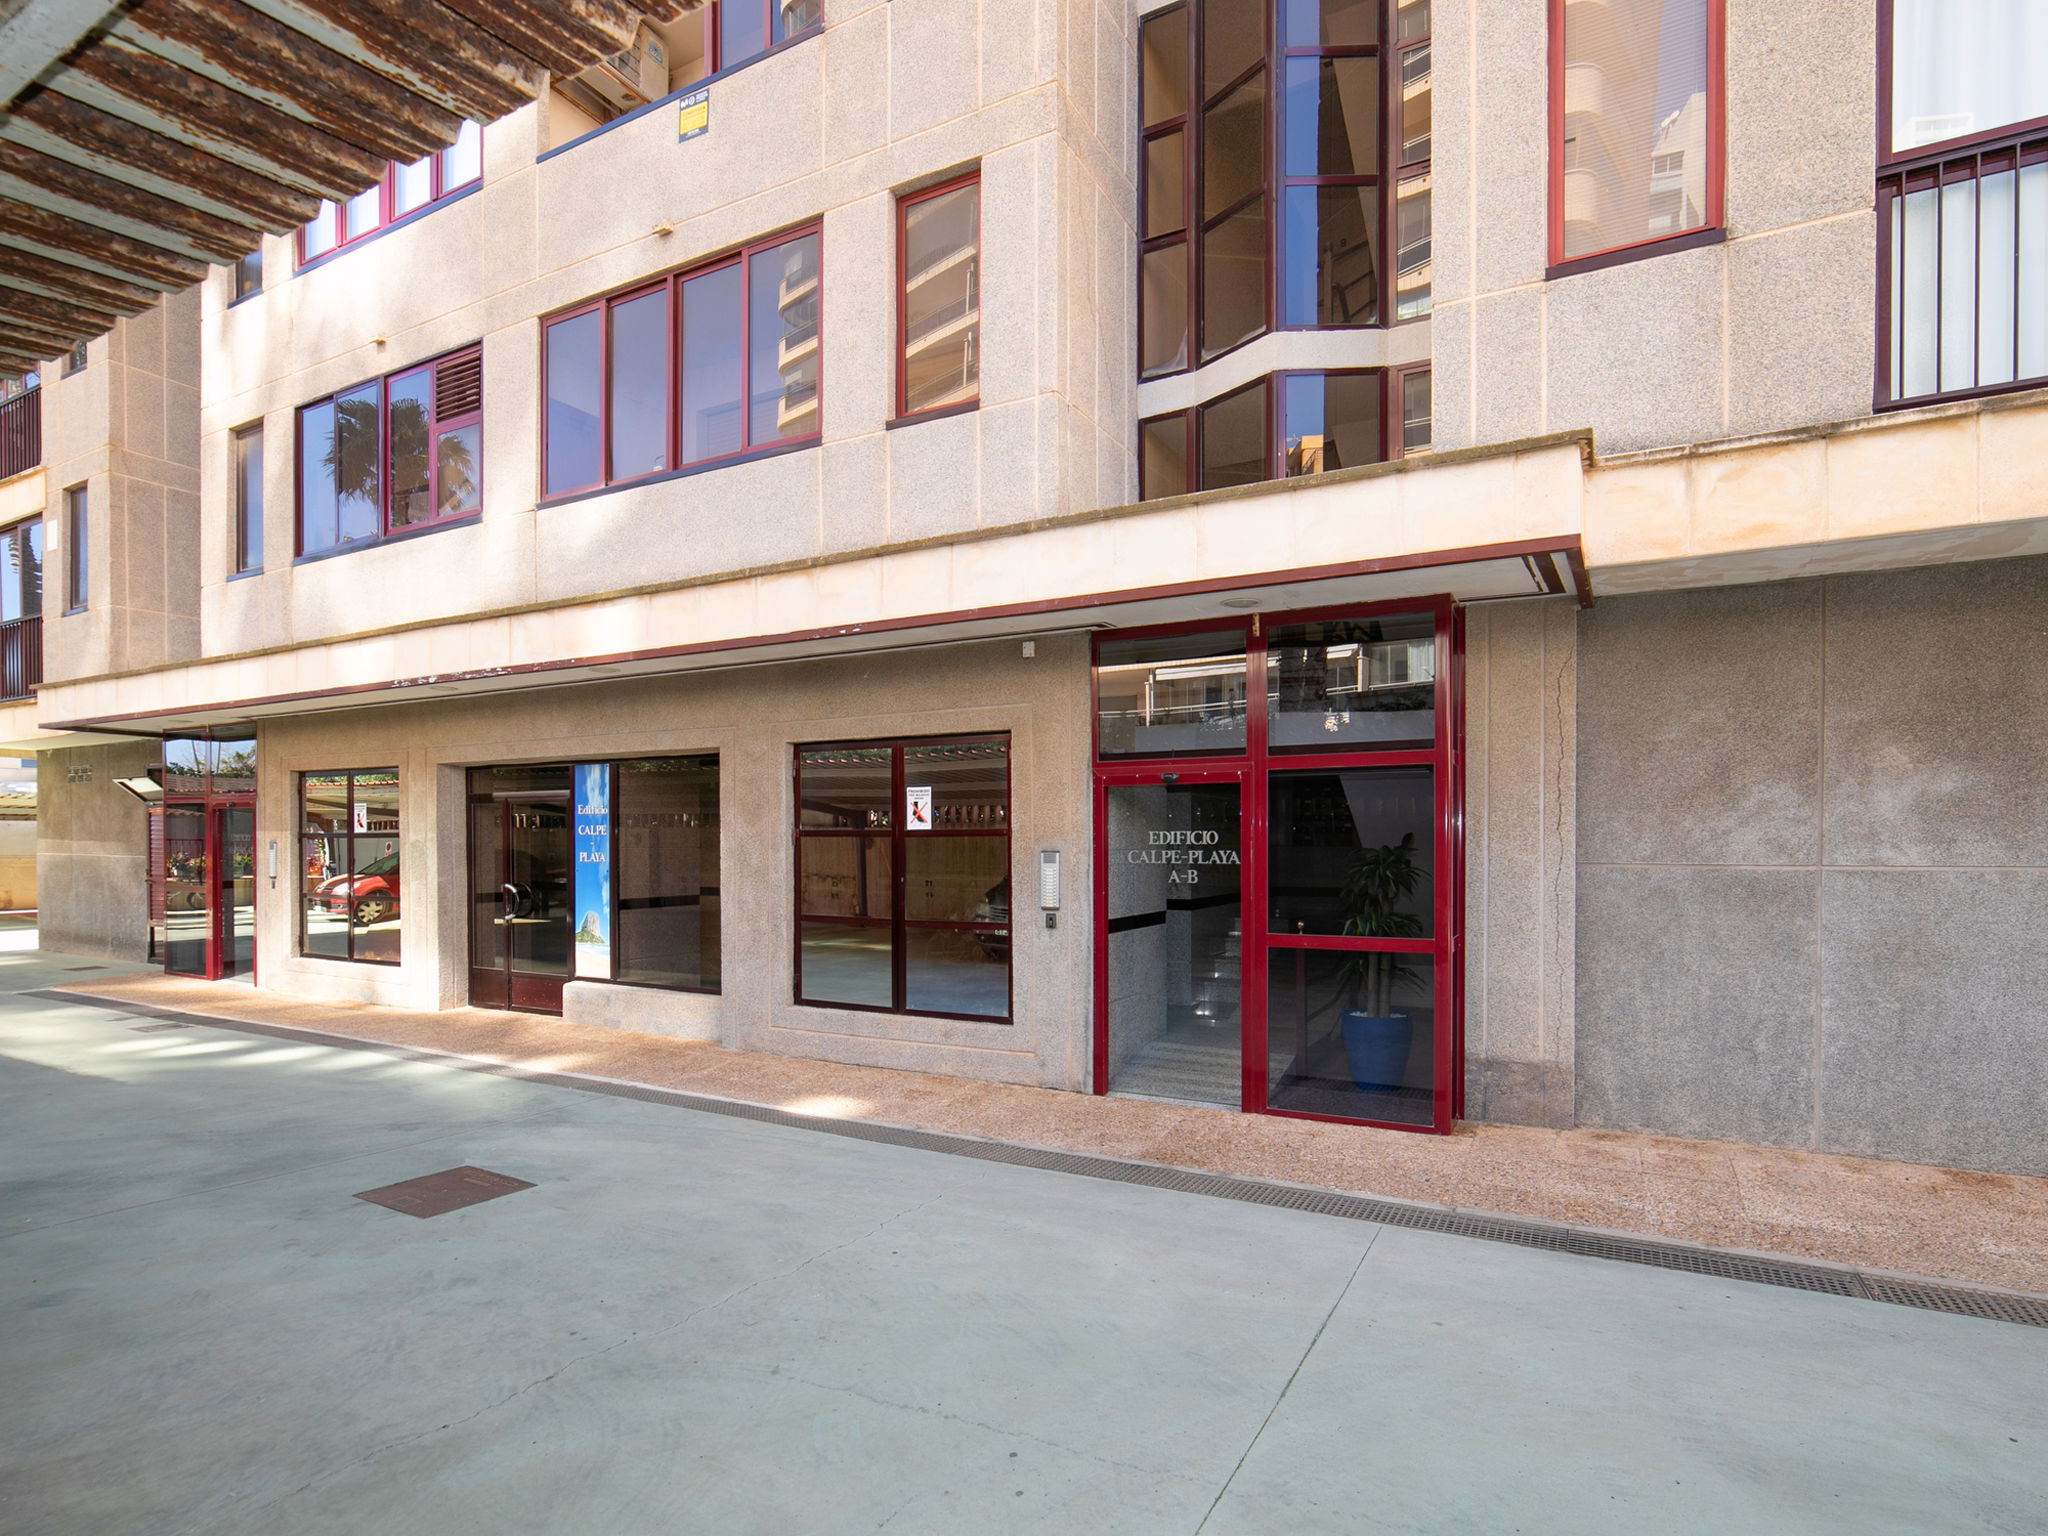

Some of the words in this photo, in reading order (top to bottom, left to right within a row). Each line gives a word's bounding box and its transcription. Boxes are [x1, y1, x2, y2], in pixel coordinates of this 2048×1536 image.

[577, 804, 608, 815] Edificio
[578, 824, 607, 836] CALPE
[1148, 830, 1219, 845] EDIFICIO
[579, 851, 606, 863] PLAYA
[1127, 849, 1241, 864] CALPE-PLAYA
[1168, 869, 1199, 884] A-B
